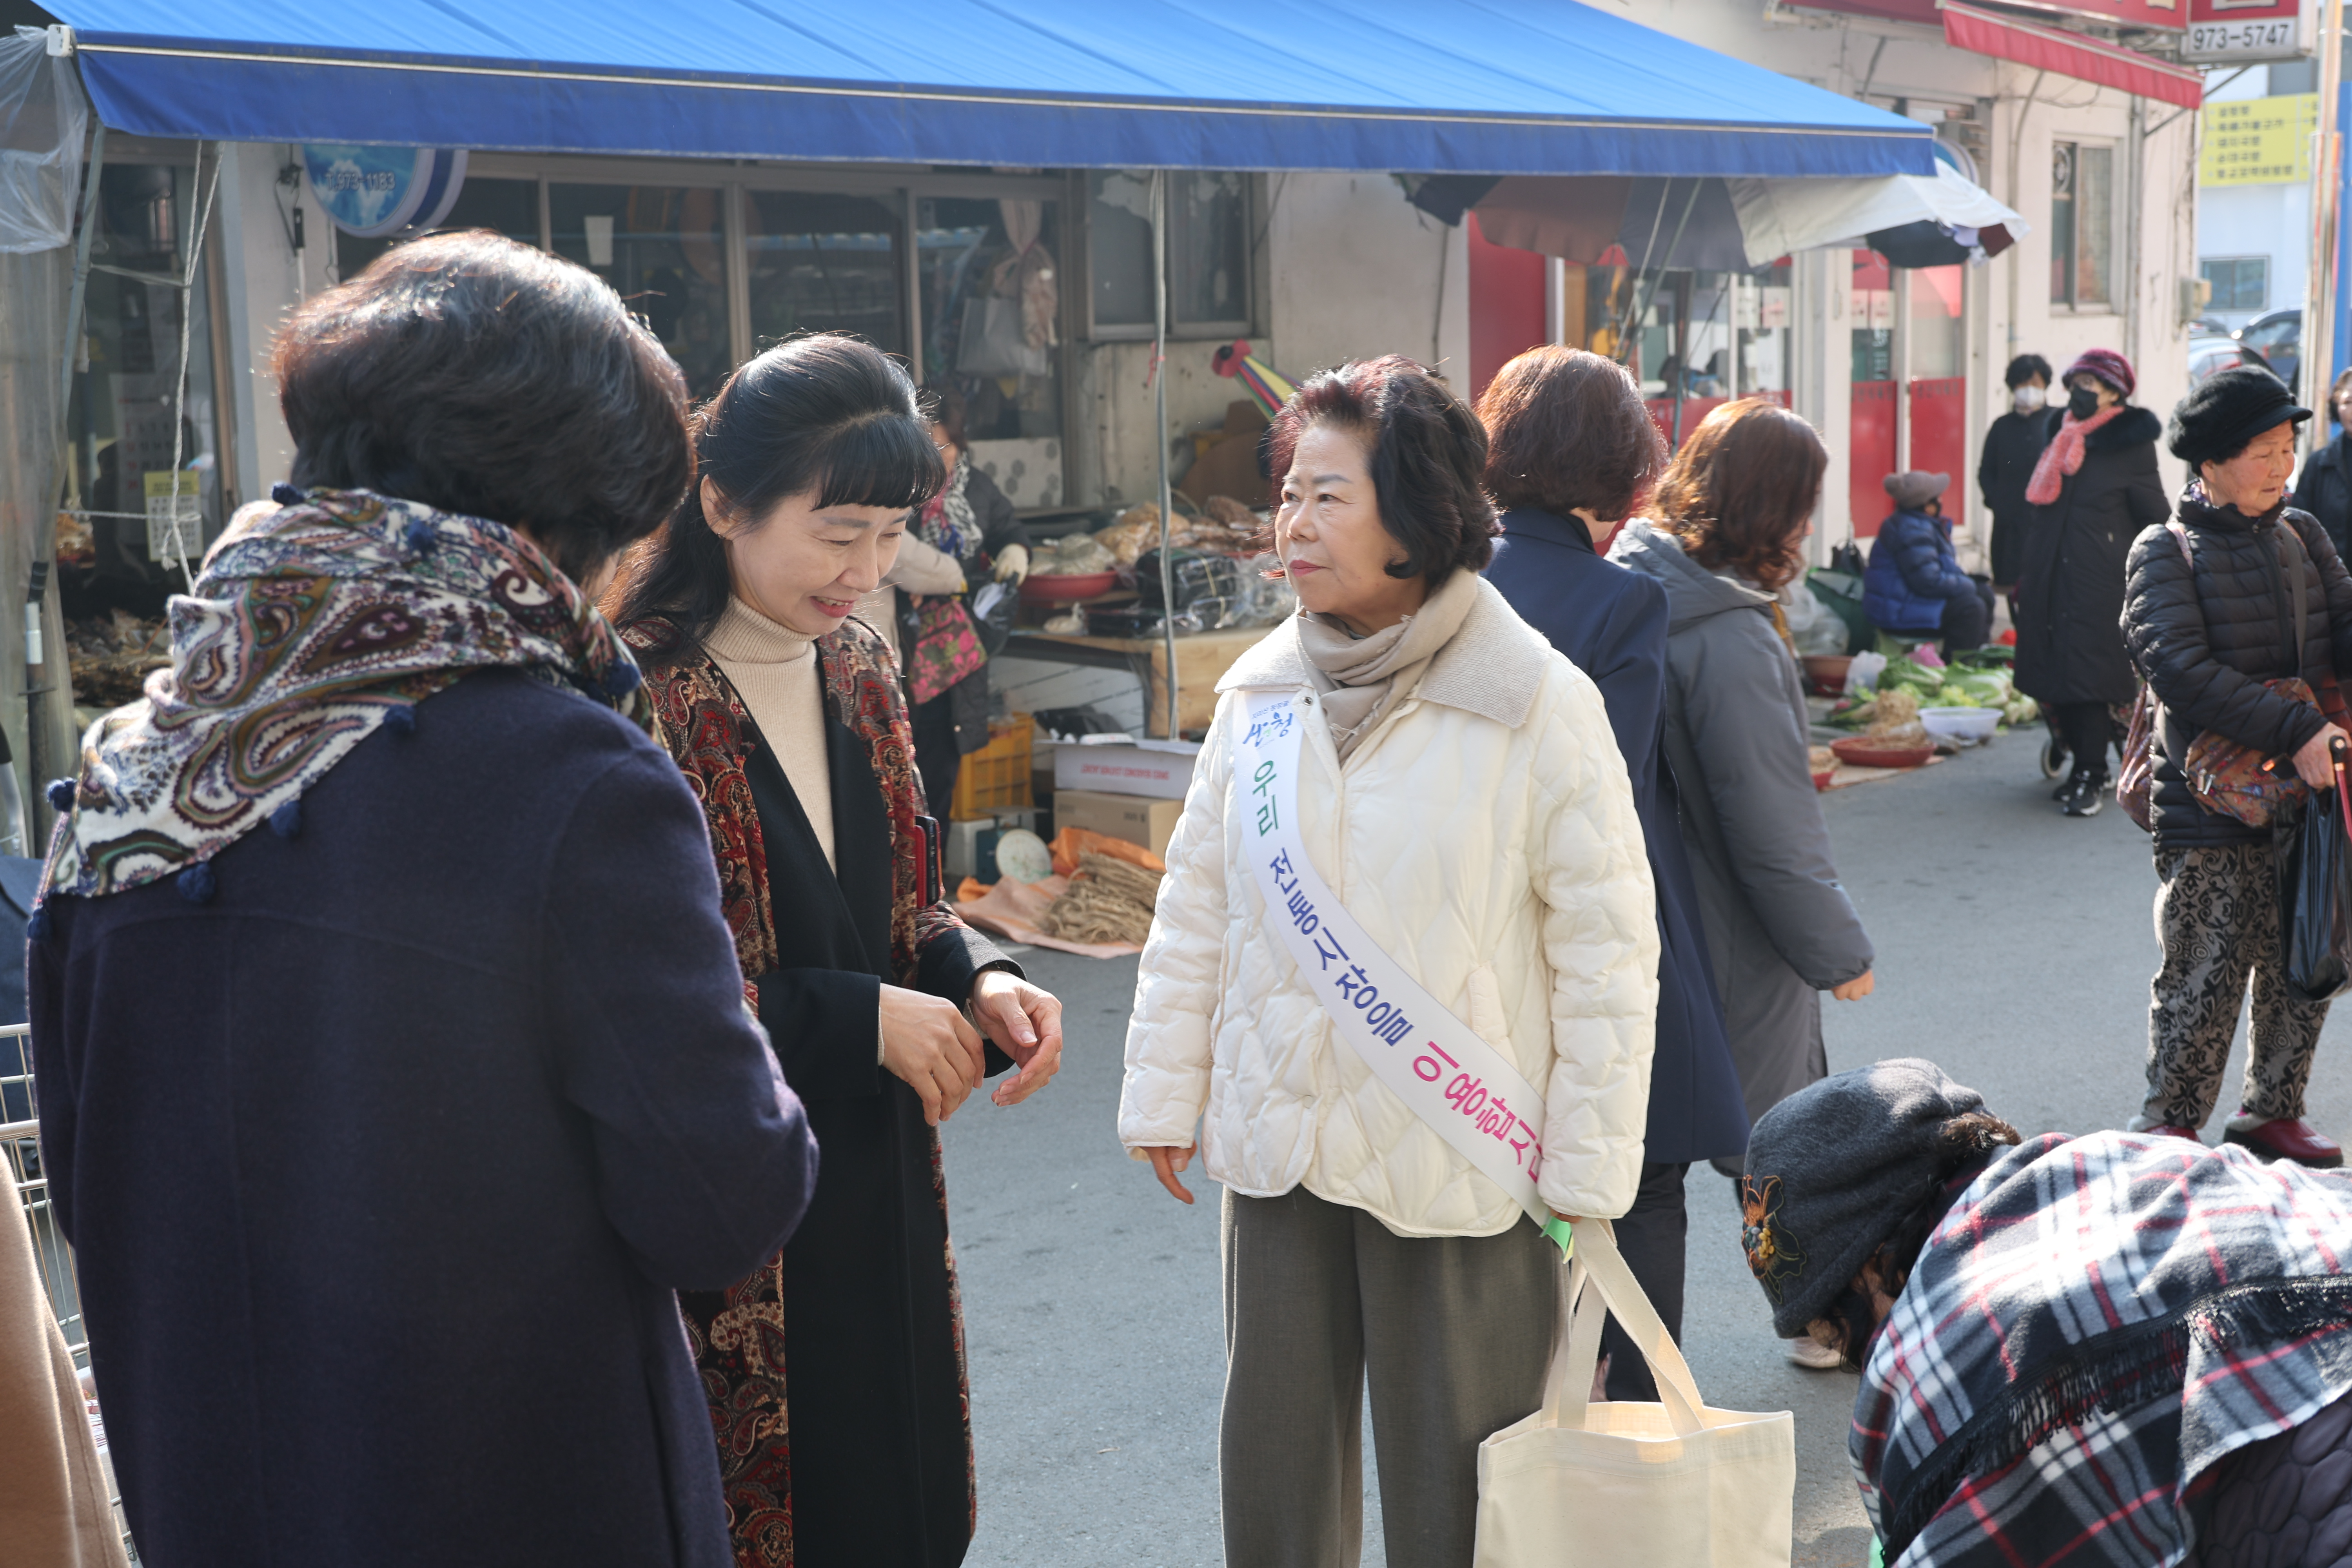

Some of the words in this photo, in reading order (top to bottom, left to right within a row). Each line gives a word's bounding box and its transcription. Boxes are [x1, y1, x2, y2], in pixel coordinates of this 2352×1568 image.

[2194, 24, 2288, 50] 973-5747
[1252, 760, 1279, 837] 우리
[1269, 847, 1414, 1047] 전통시장을
